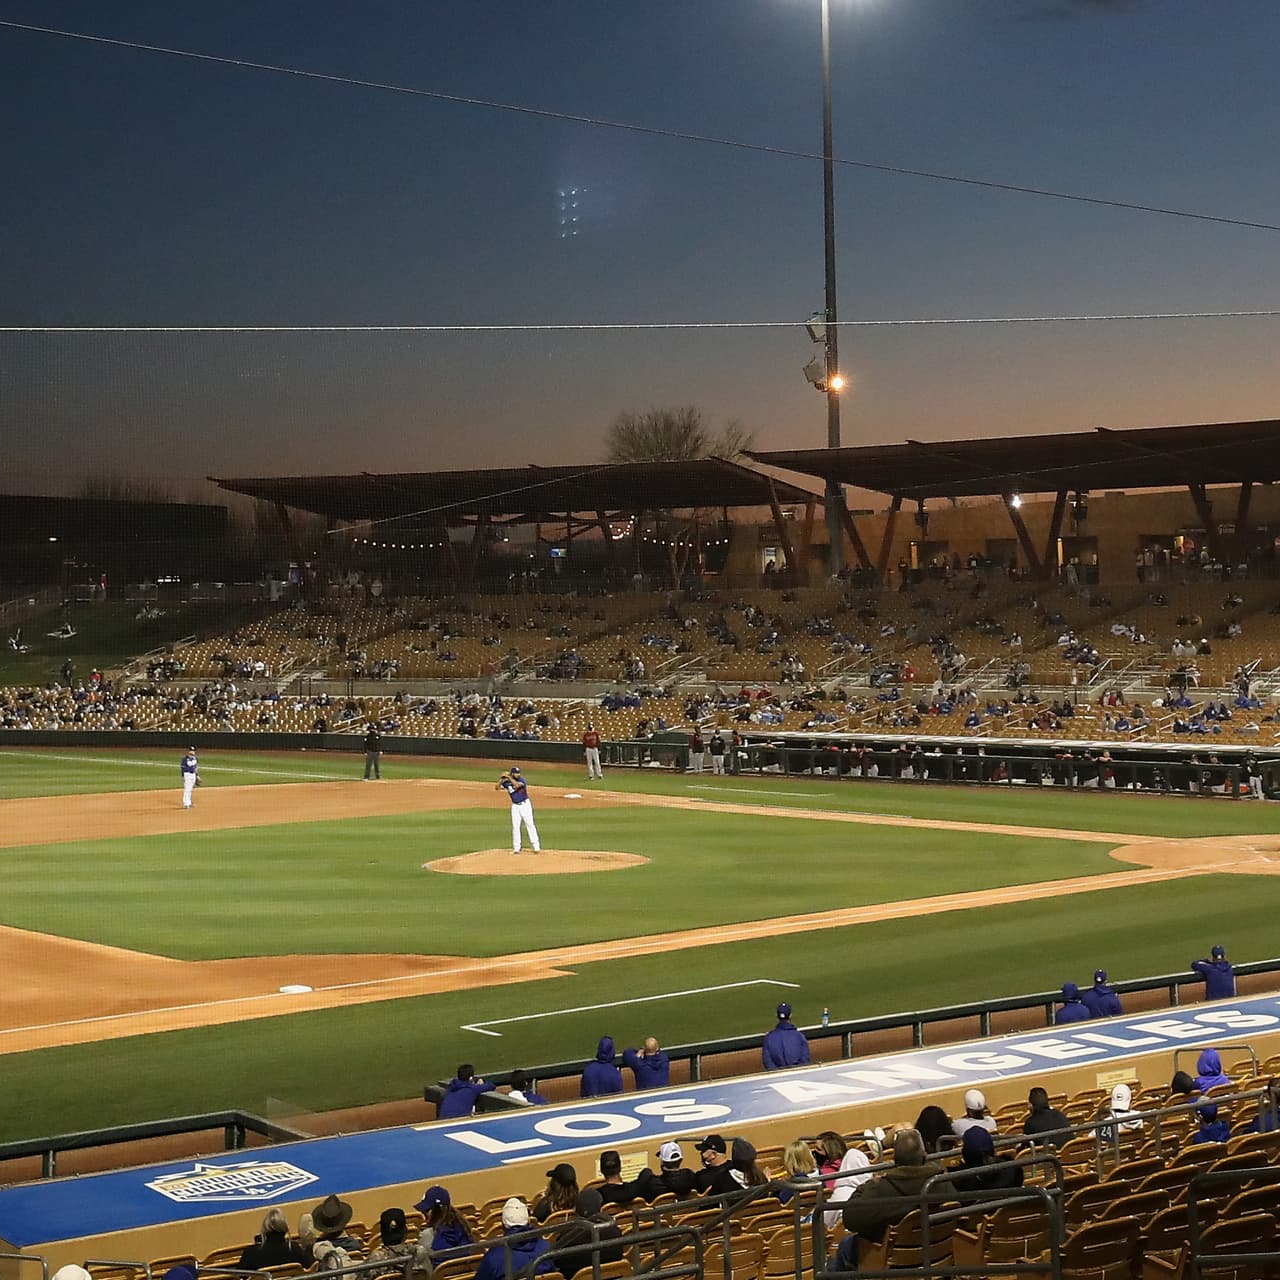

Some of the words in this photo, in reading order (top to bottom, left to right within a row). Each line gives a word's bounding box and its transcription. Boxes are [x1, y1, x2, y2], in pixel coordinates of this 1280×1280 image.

[443, 1097, 732, 1154] LOS
[767, 1009, 1280, 1104] ANGELES
[1100, 1126, 1113, 1138] 24
